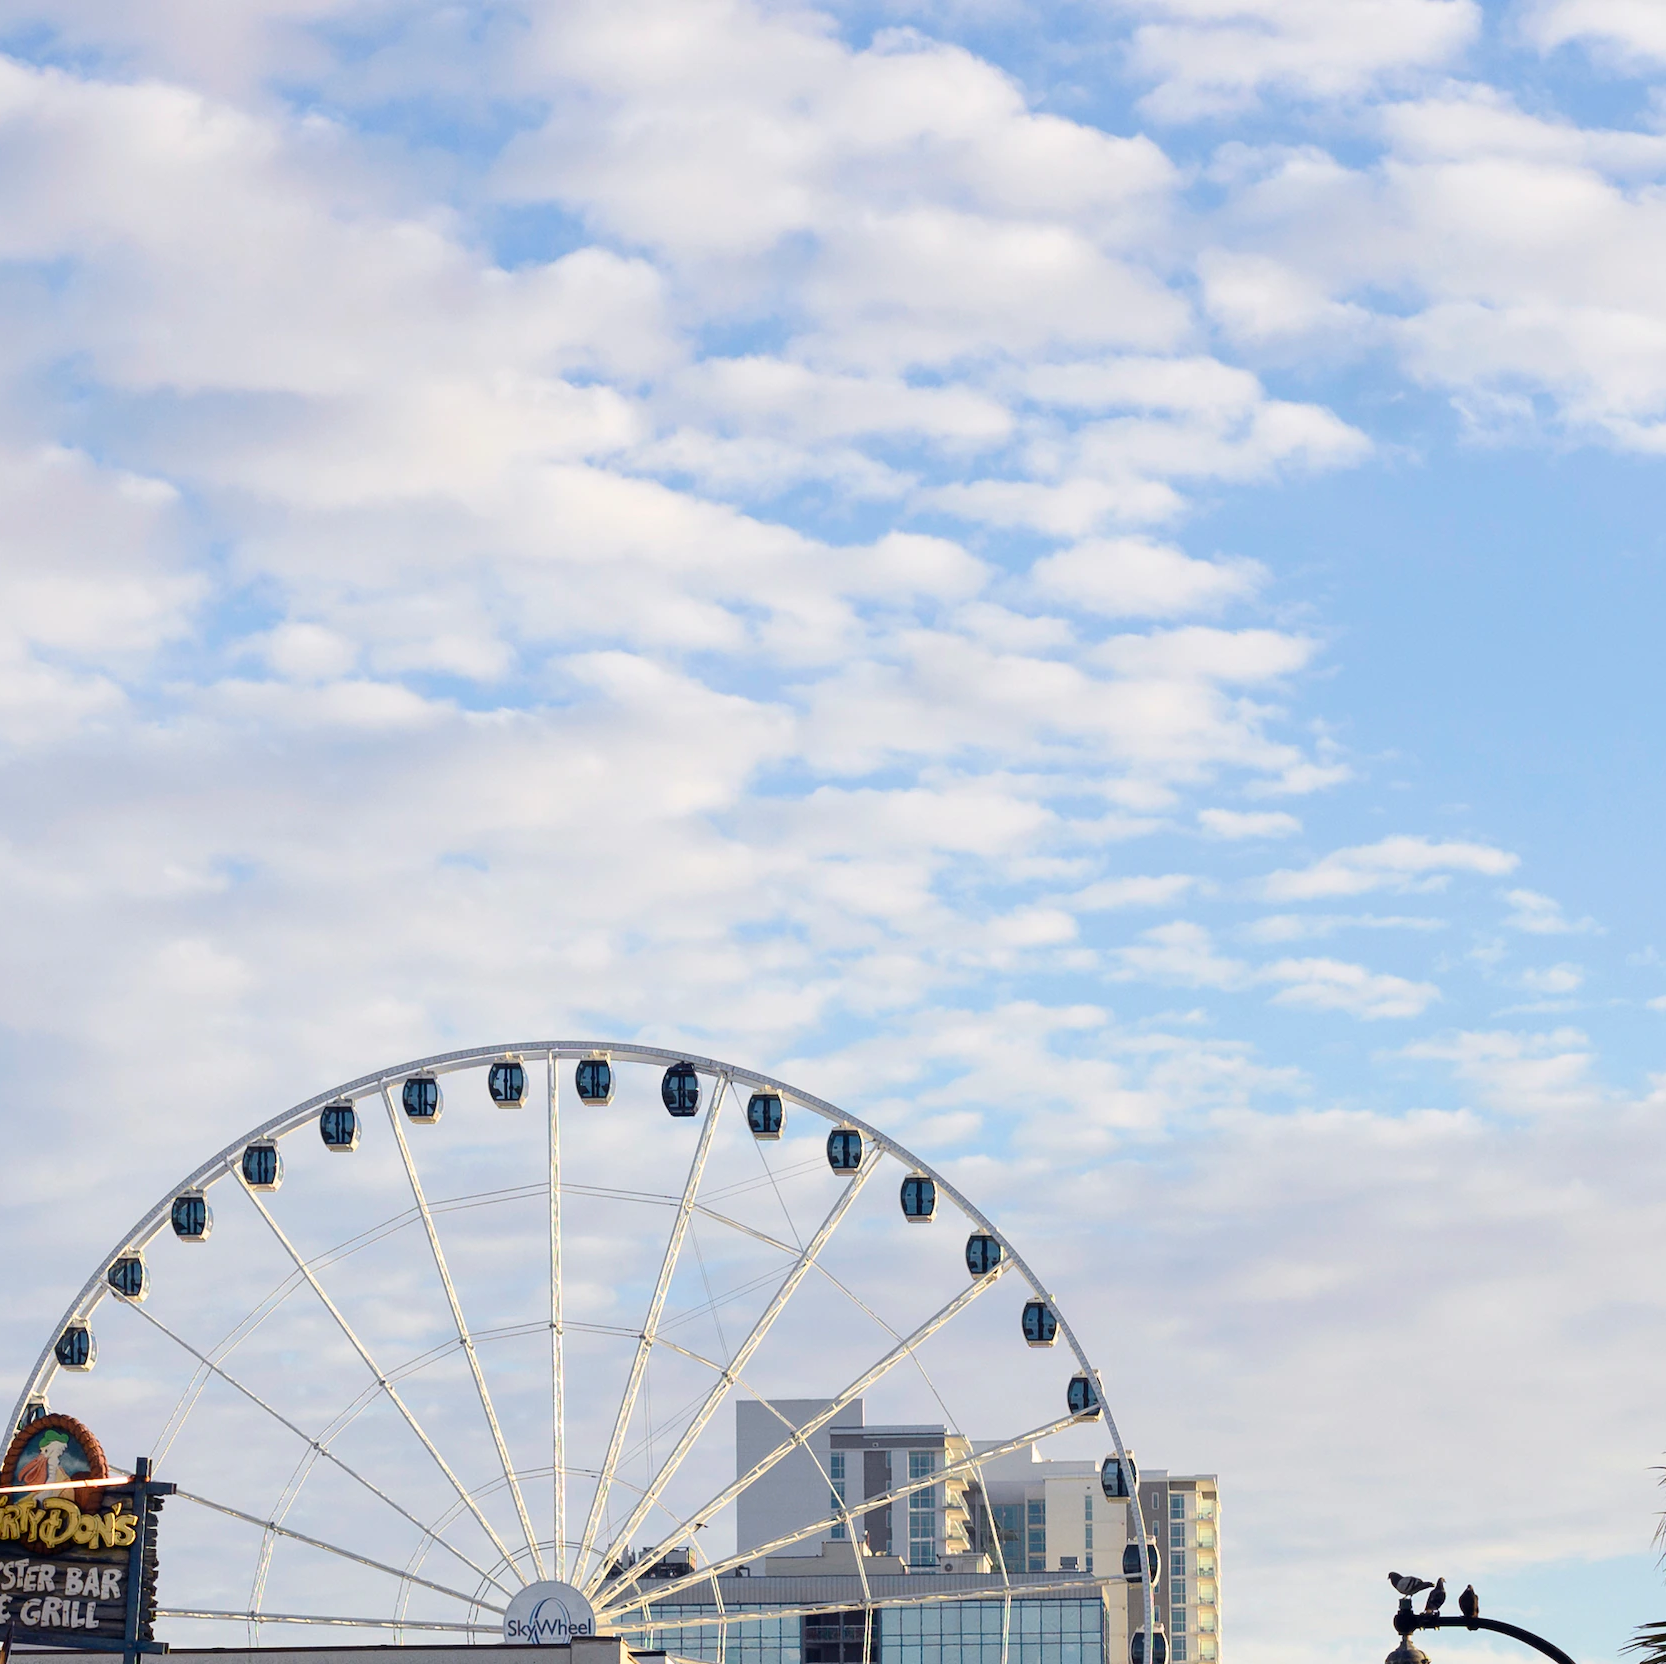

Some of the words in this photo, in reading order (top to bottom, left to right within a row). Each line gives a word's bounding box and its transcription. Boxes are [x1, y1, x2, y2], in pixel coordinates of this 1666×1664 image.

[64, 1567, 122, 1600] BAR
[20, 1596, 99, 1629] GRILL
[507, 1618, 591, 1641] SkyWheel
